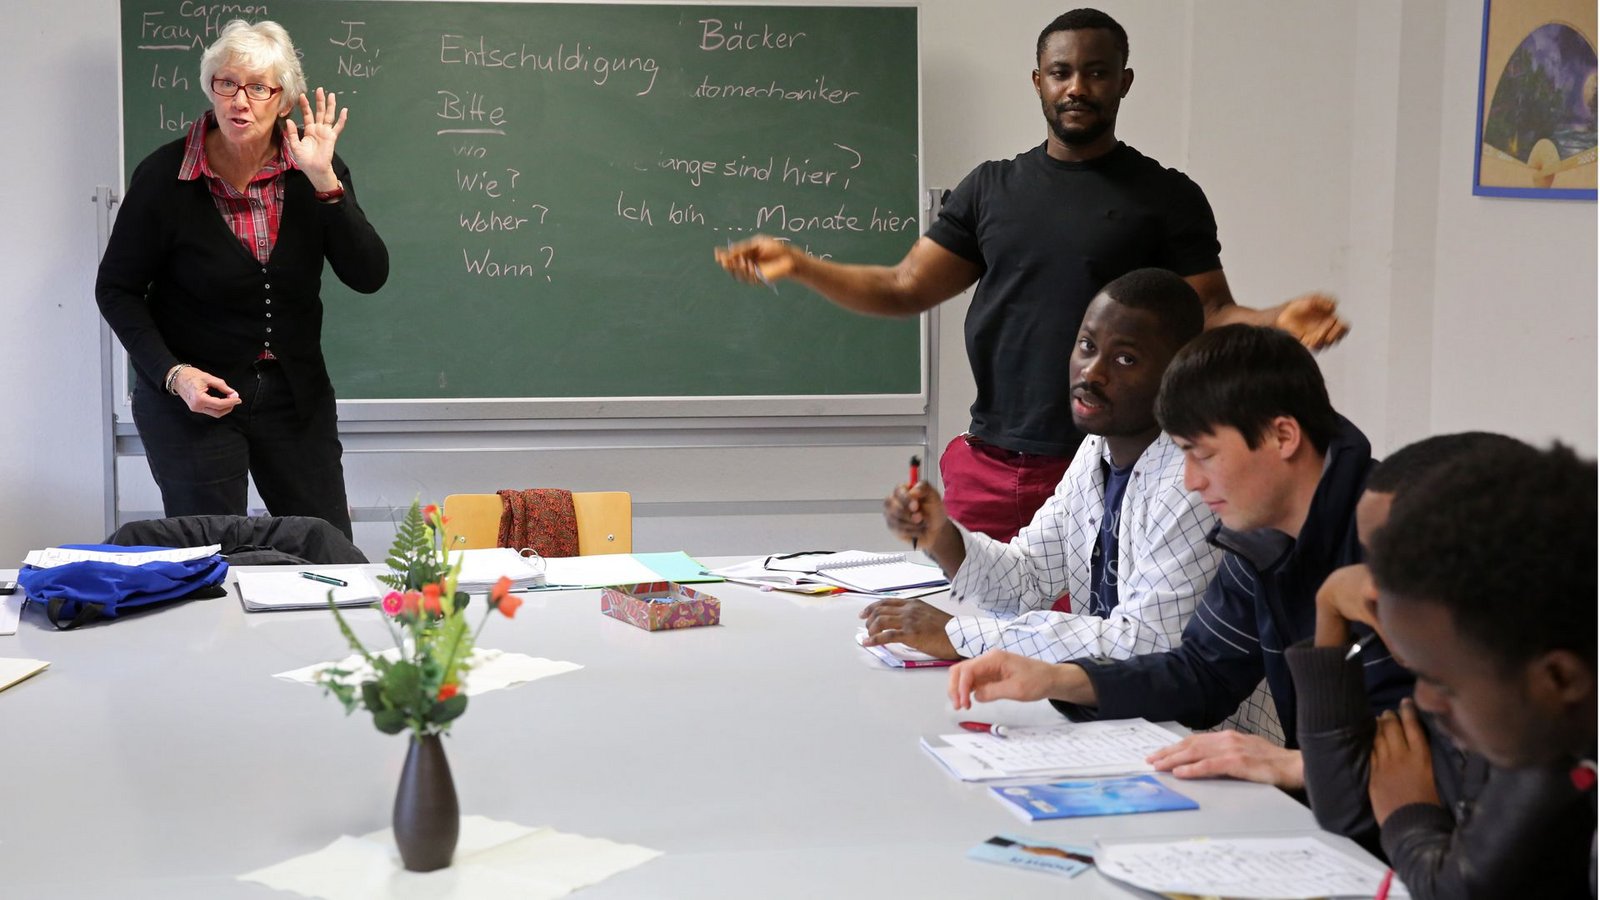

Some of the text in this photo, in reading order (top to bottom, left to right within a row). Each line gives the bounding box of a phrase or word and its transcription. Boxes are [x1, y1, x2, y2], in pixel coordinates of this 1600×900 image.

[142, 11, 191, 40] Frau
[699, 19, 806, 50] Bäcker
[152, 64, 188, 91] Ich
[440, 34, 659, 96] Entschuldigung
[690, 75, 860, 104] utomechaniker
[437, 91, 507, 125] Bitte
[659, 158, 717, 187] ange
[723, 155, 773, 182] sind
[617, 191, 653, 226] Ich
[669, 202, 704, 225] bin
[756, 204, 864, 232] Monate
[870, 207, 917, 232] hier
